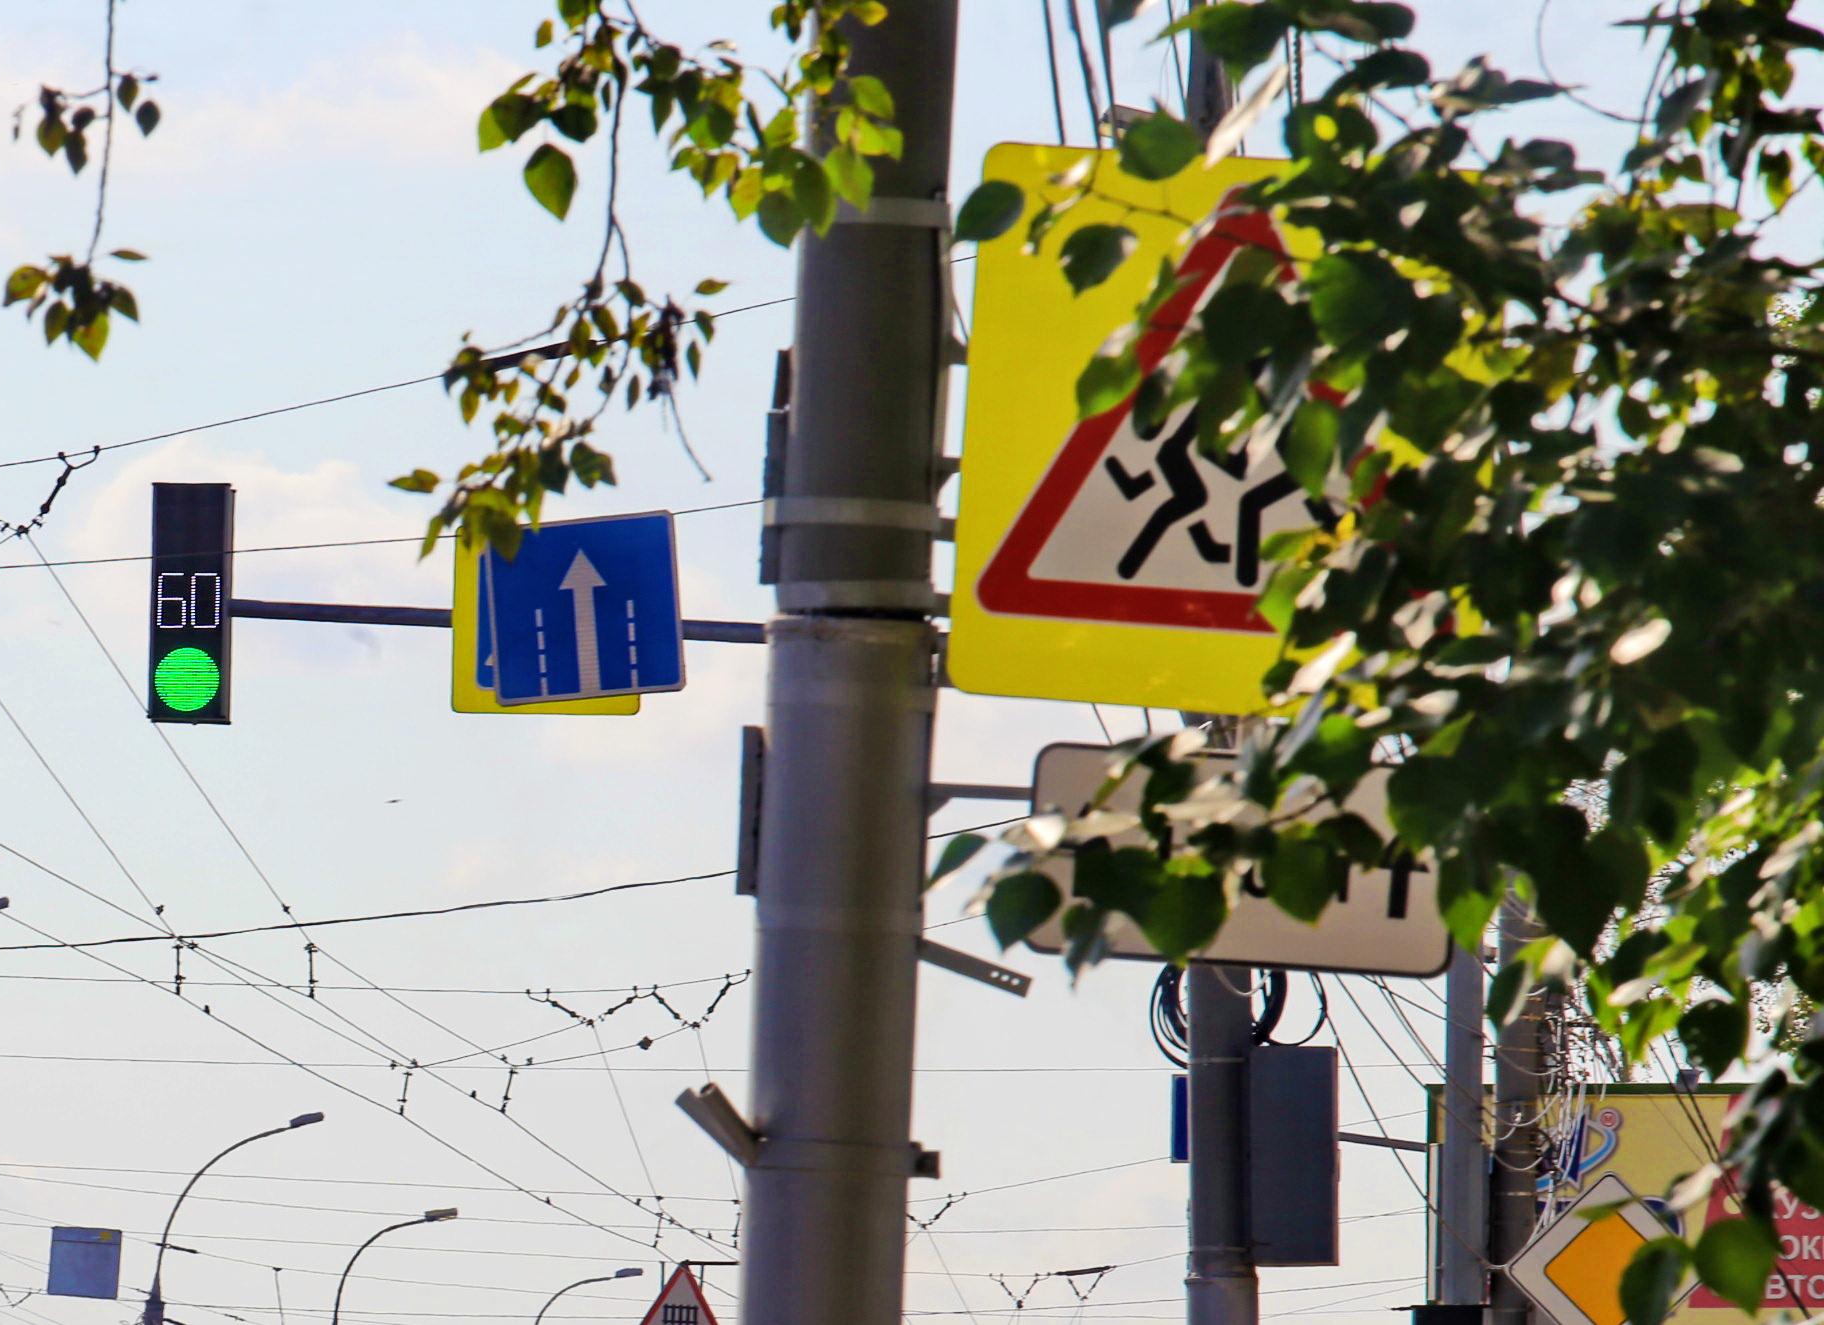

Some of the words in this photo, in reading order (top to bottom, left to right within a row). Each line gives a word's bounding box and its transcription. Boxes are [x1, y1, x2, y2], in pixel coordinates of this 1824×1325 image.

[157, 572, 220, 629] 60
[1778, 1235, 1824, 1261] ОК
[1765, 1274, 1824, 1300] ВТО
